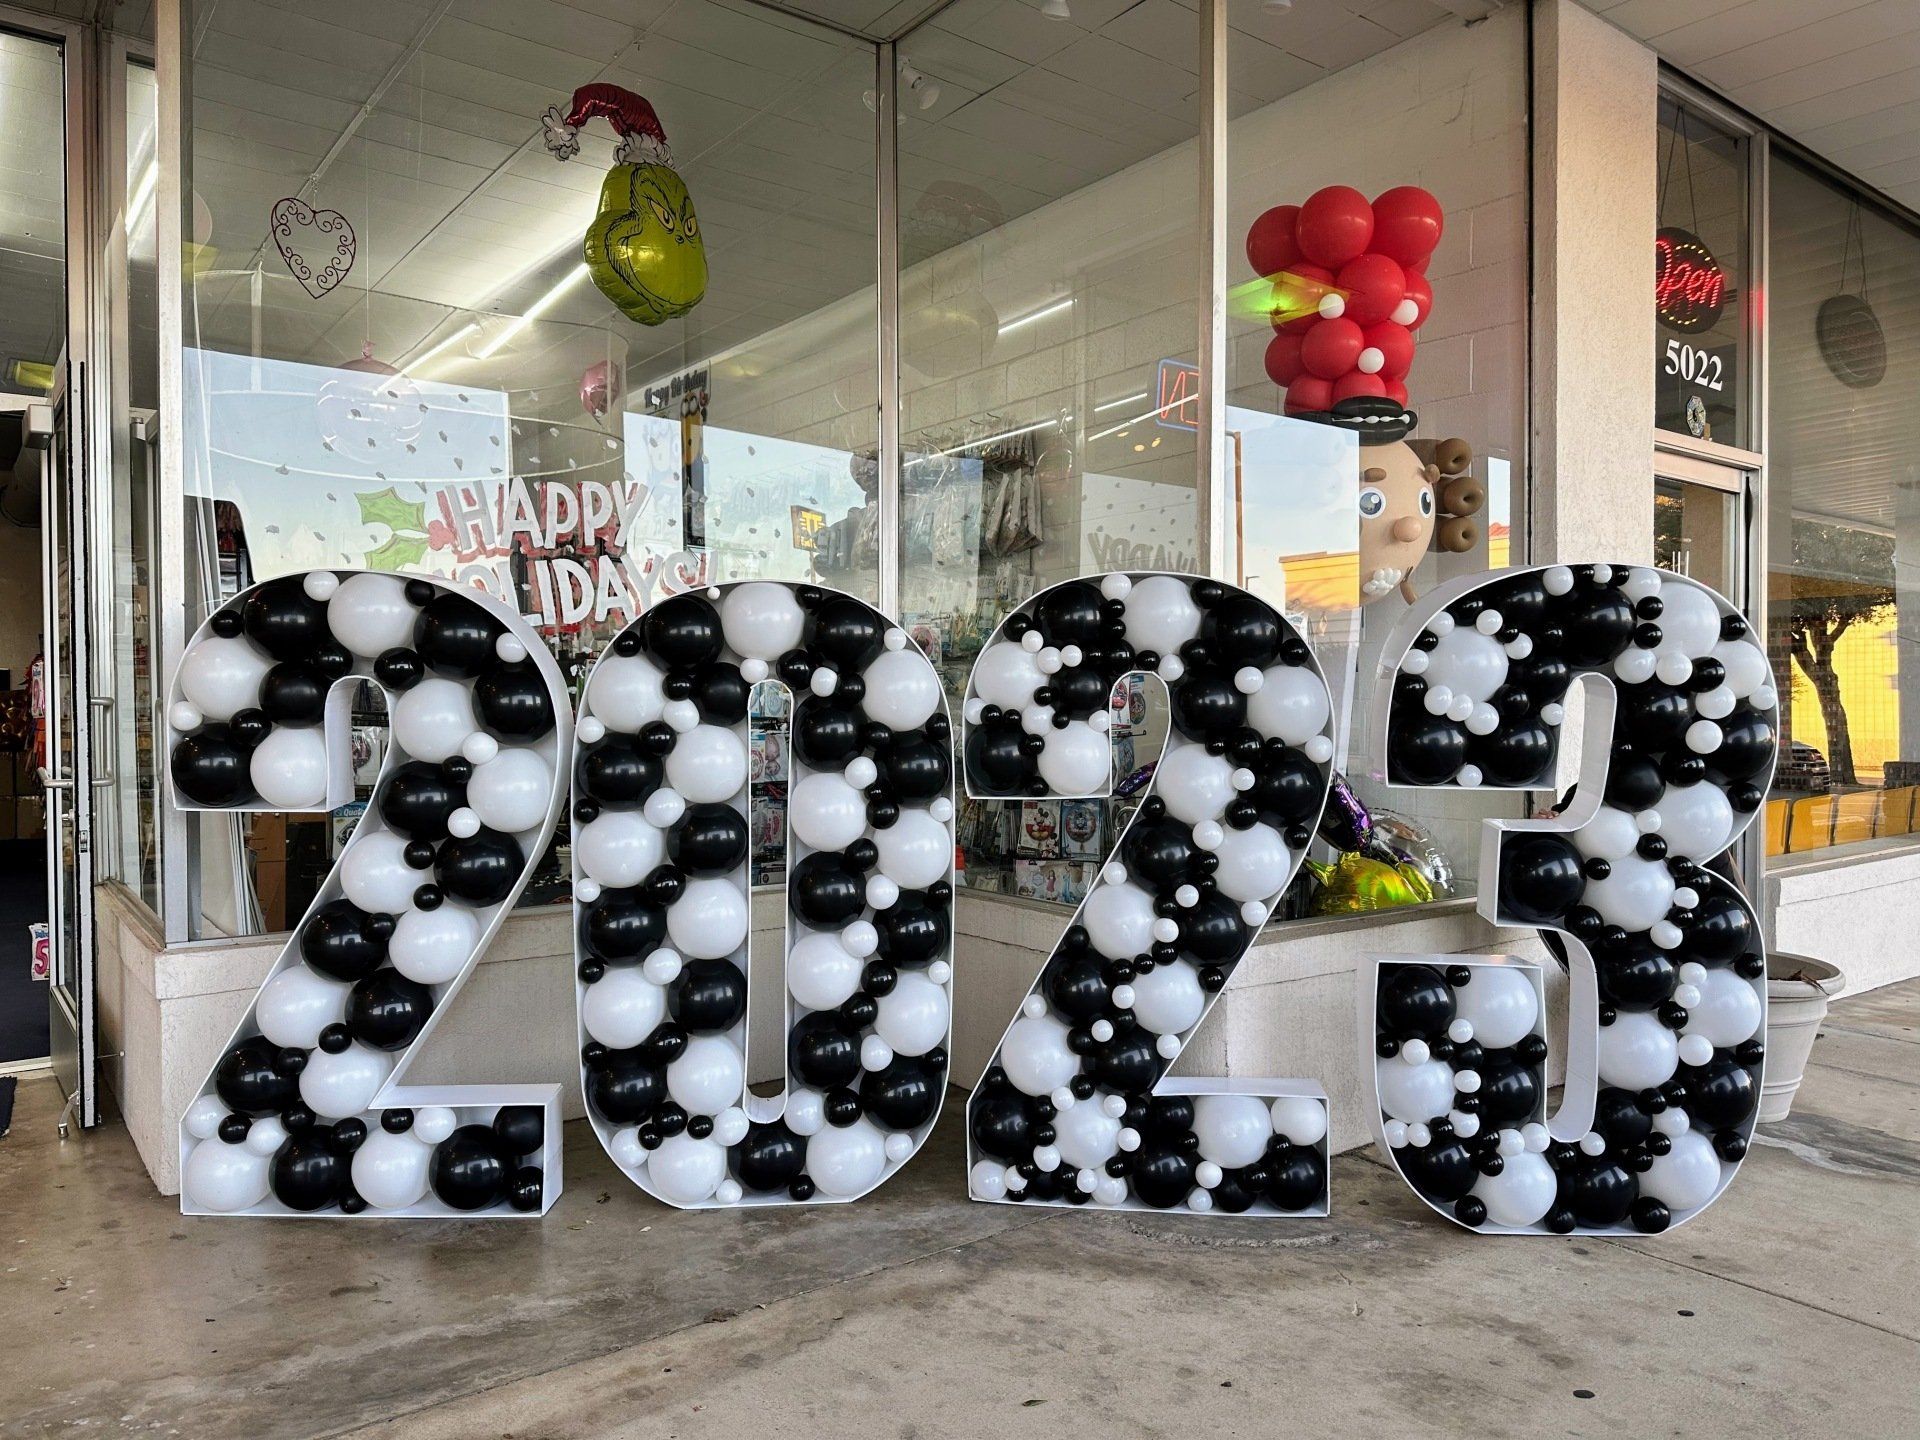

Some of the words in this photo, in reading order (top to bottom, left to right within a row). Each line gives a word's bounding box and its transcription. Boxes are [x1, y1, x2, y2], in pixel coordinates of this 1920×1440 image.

[1665, 339, 1723, 391] 5022
[438, 476, 649, 553] HAPPY
[433, 550, 718, 628] LIDAYS!
